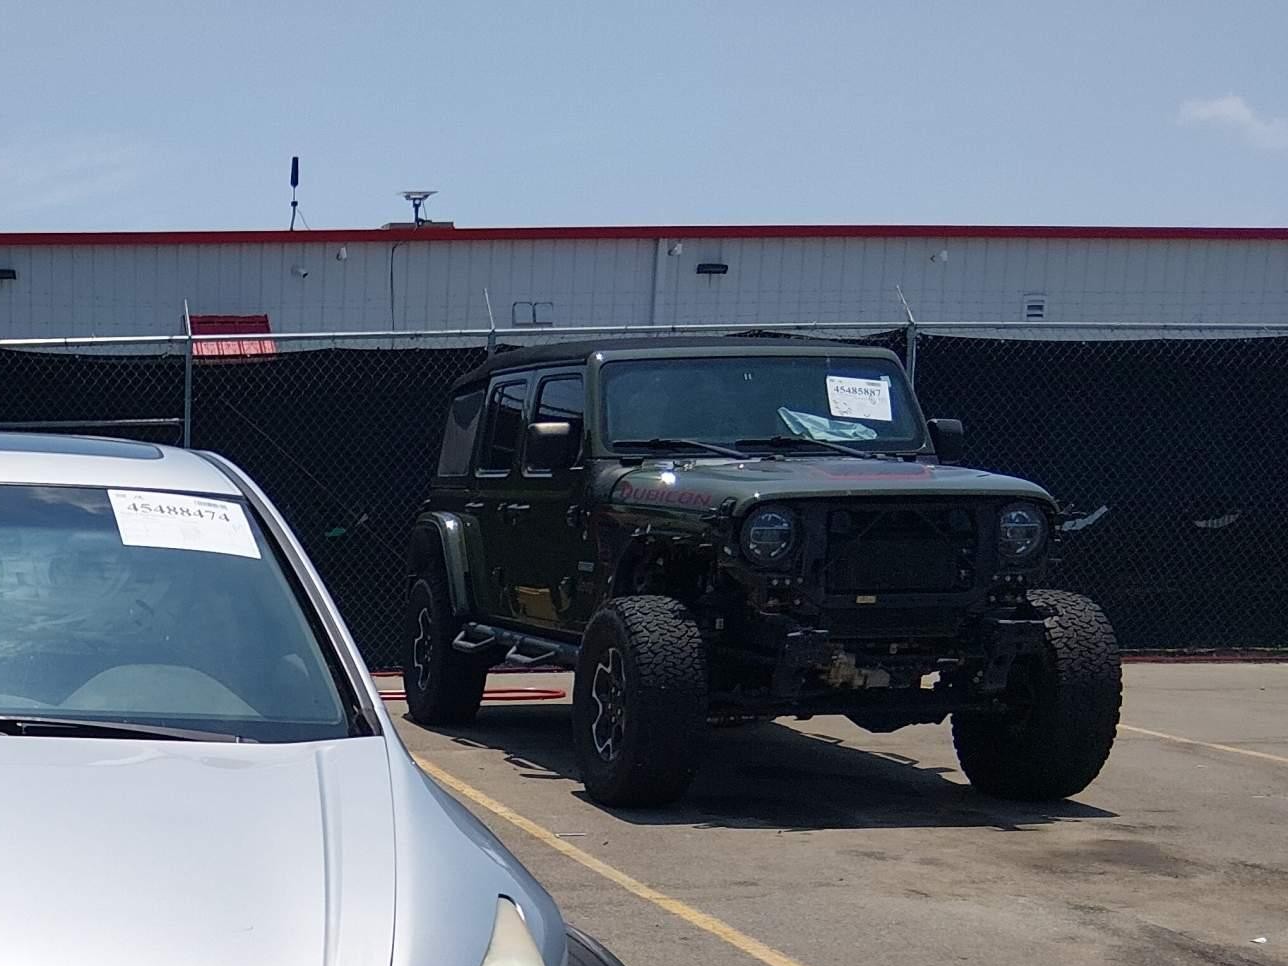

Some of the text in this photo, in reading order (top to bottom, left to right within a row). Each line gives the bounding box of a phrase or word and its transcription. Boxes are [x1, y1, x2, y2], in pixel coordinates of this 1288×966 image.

[833, 385, 881, 397] 45485887
[620, 481, 713, 506] RUBICON
[127, 502, 231, 522] 45488474
